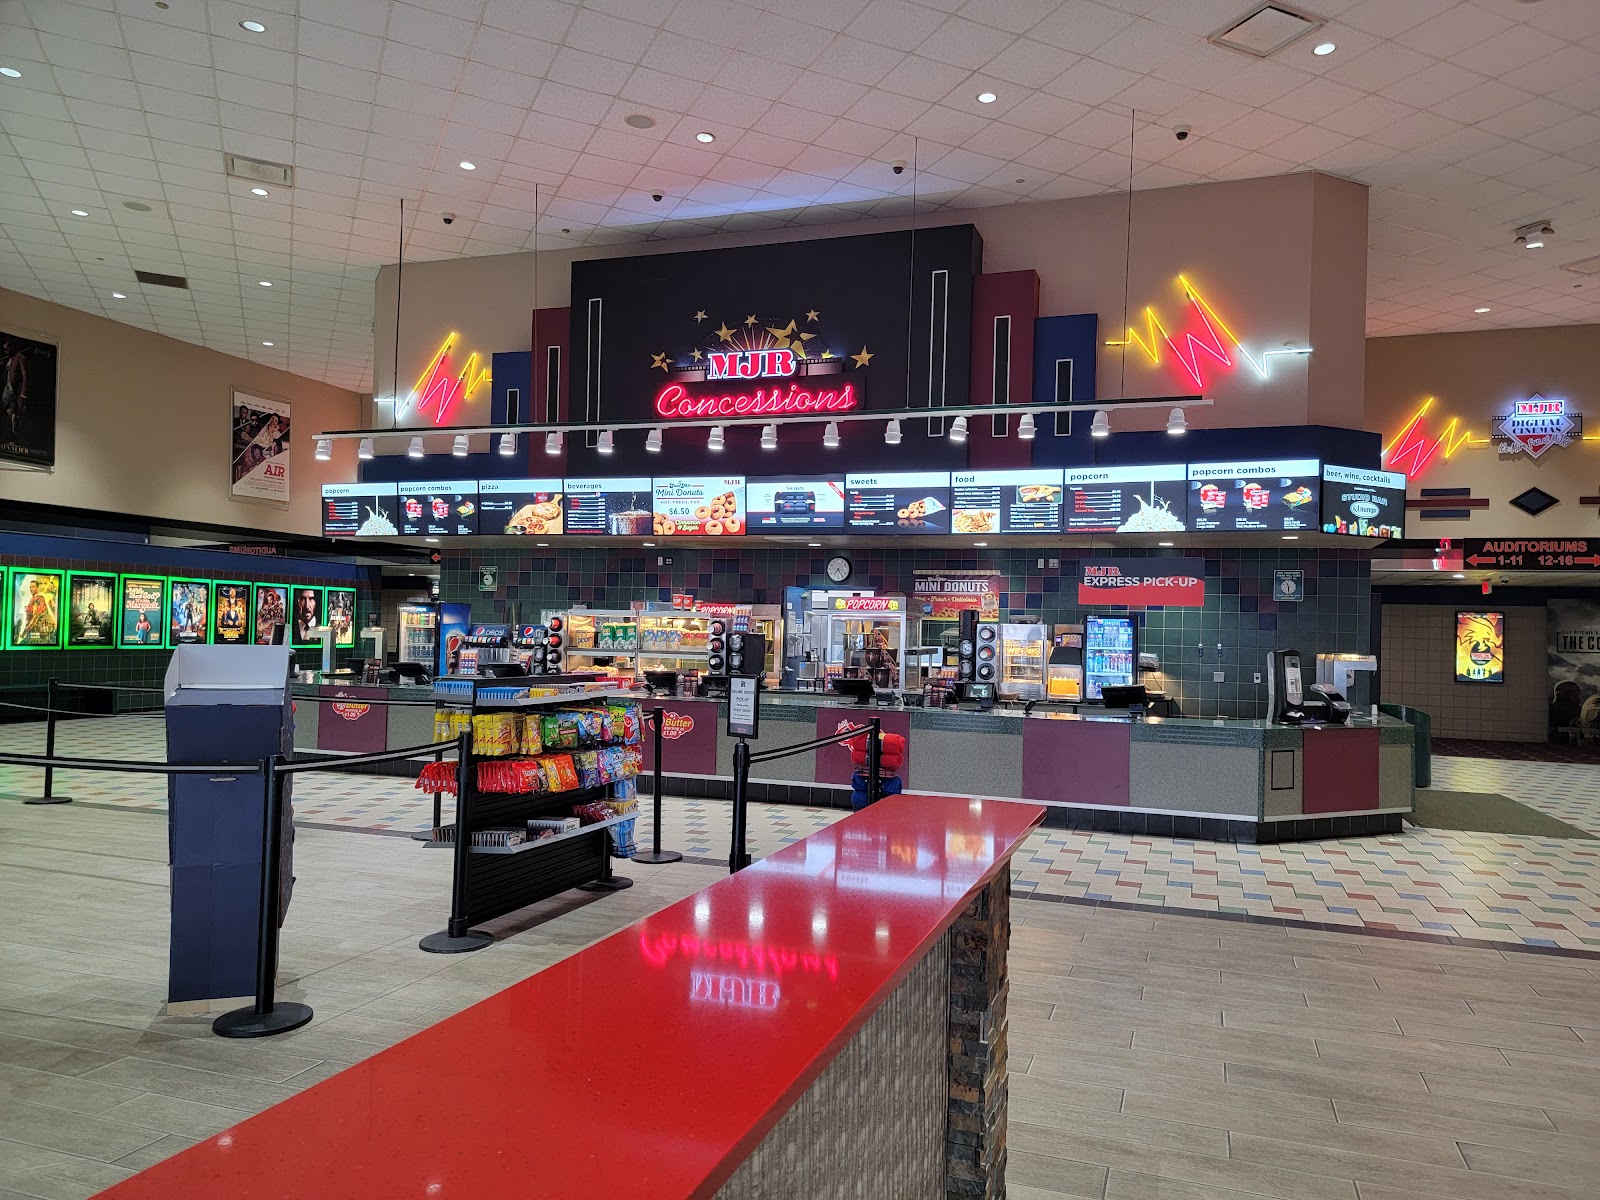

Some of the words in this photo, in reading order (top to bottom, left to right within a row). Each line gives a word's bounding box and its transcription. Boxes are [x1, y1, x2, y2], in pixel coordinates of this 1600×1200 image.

[707, 349, 797, 380] MJR
[656, 384, 855, 417] Concessions
[1518, 402, 1562, 415] MJR
[1511, 418, 1563, 428] DIGITAL
[1513, 427, 1562, 435] CINEMAS
[264, 464, 285, 477] AIR
[1192, 468, 1234, 476] popcorn
[1236, 466, 1277, 474] combos
[955, 475, 975, 483] food
[1070, 473, 1109, 481] popcorn
[1326, 469, 1343, 479] beer,
[1344, 472, 1362, 481] wine,
[1362, 474, 1391, 484] cocktails
[325, 488, 350, 496] popcorn
[481, 483, 499, 491] pizza
[655, 488, 675, 497] Mini
[676, 488, 704, 497] Donuts
[668, 507, 690, 515] $6.50
[1483, 540, 1588, 553] AUDITORIUMS
[1497, 555, 1524, 566] 1-11
[1538, 555, 1574, 566] 12-16
[1084, 566, 1122, 577] MJR
[915, 581, 941, 592] MINI
[944, 581, 989, 592] DONUTS
[1083, 576, 1140, 587] EXPRESS
[1143, 577, 1198, 587] PICK-UP
[846, 599, 888, 610] POPCORN
[485, 629, 505, 637] pepsi
[1562, 636, 1584, 650] THE
[665, 718, 692, 727] Butter
